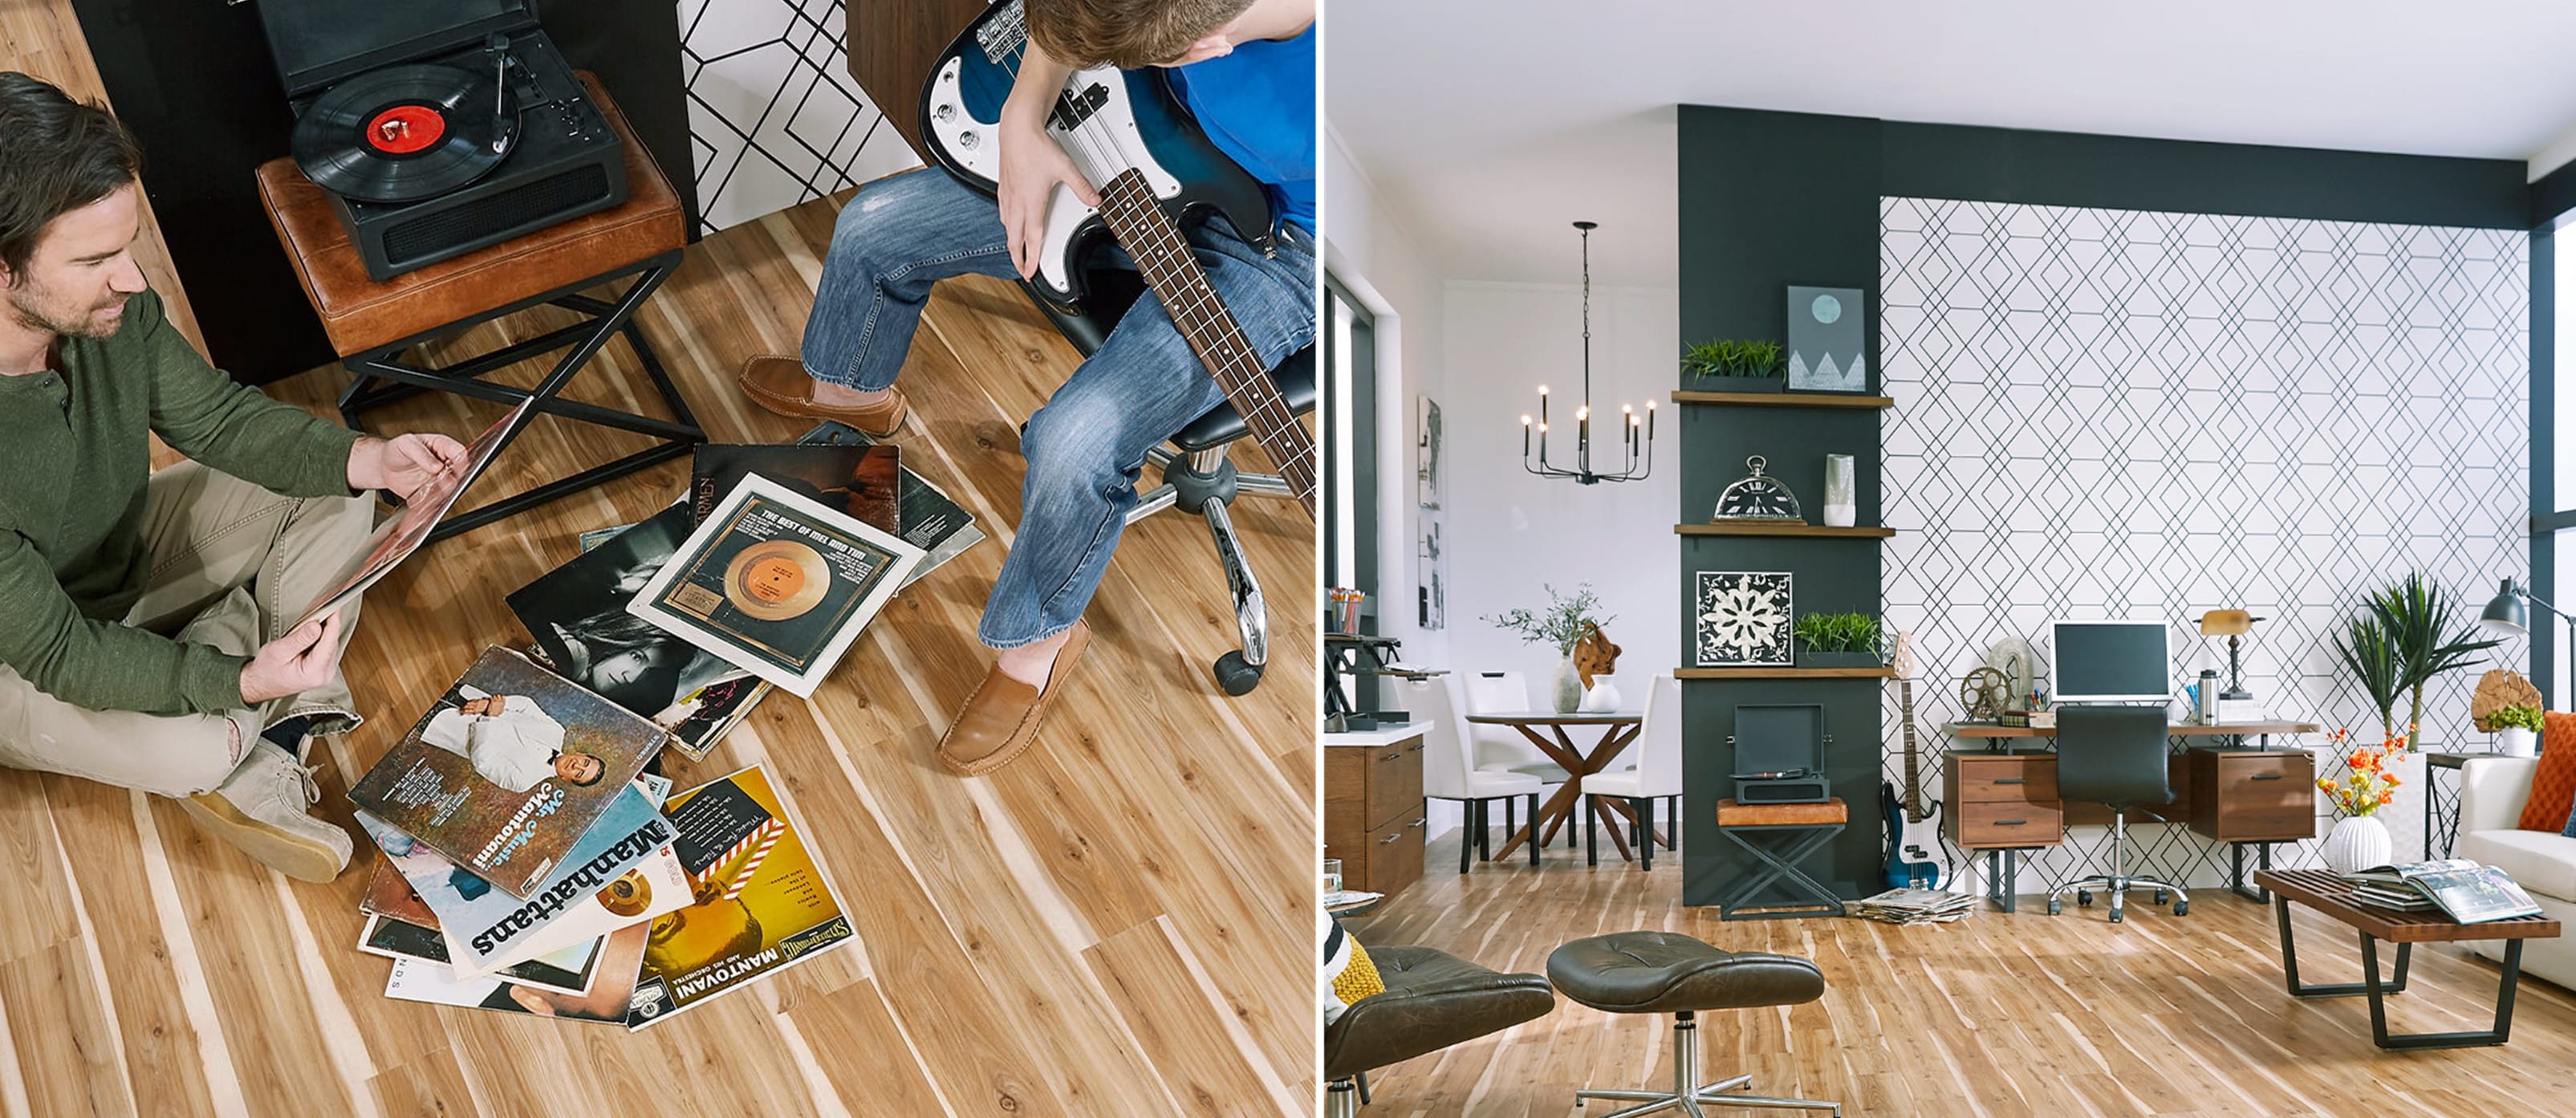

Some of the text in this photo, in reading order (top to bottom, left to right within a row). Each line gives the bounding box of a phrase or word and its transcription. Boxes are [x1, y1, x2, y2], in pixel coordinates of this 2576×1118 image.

[762, 509, 779, 522] THE
[777, 516, 801, 531] BEST
[798, 526, 811, 535] OF
[808, 531, 830, 544] MEL
[827, 539, 848, 552] AND
[847, 547, 867, 560] TIM
[472, 783, 552, 870] Mantovani
[535, 790, 564, 817] Mr.
[485, 820, 537, 871] Music...
[471, 819, 671, 957] Manhattans
[672, 953, 741, 986] AND HIS ORCHESTRA
[676, 948, 779, 1000] MANTOVANI
